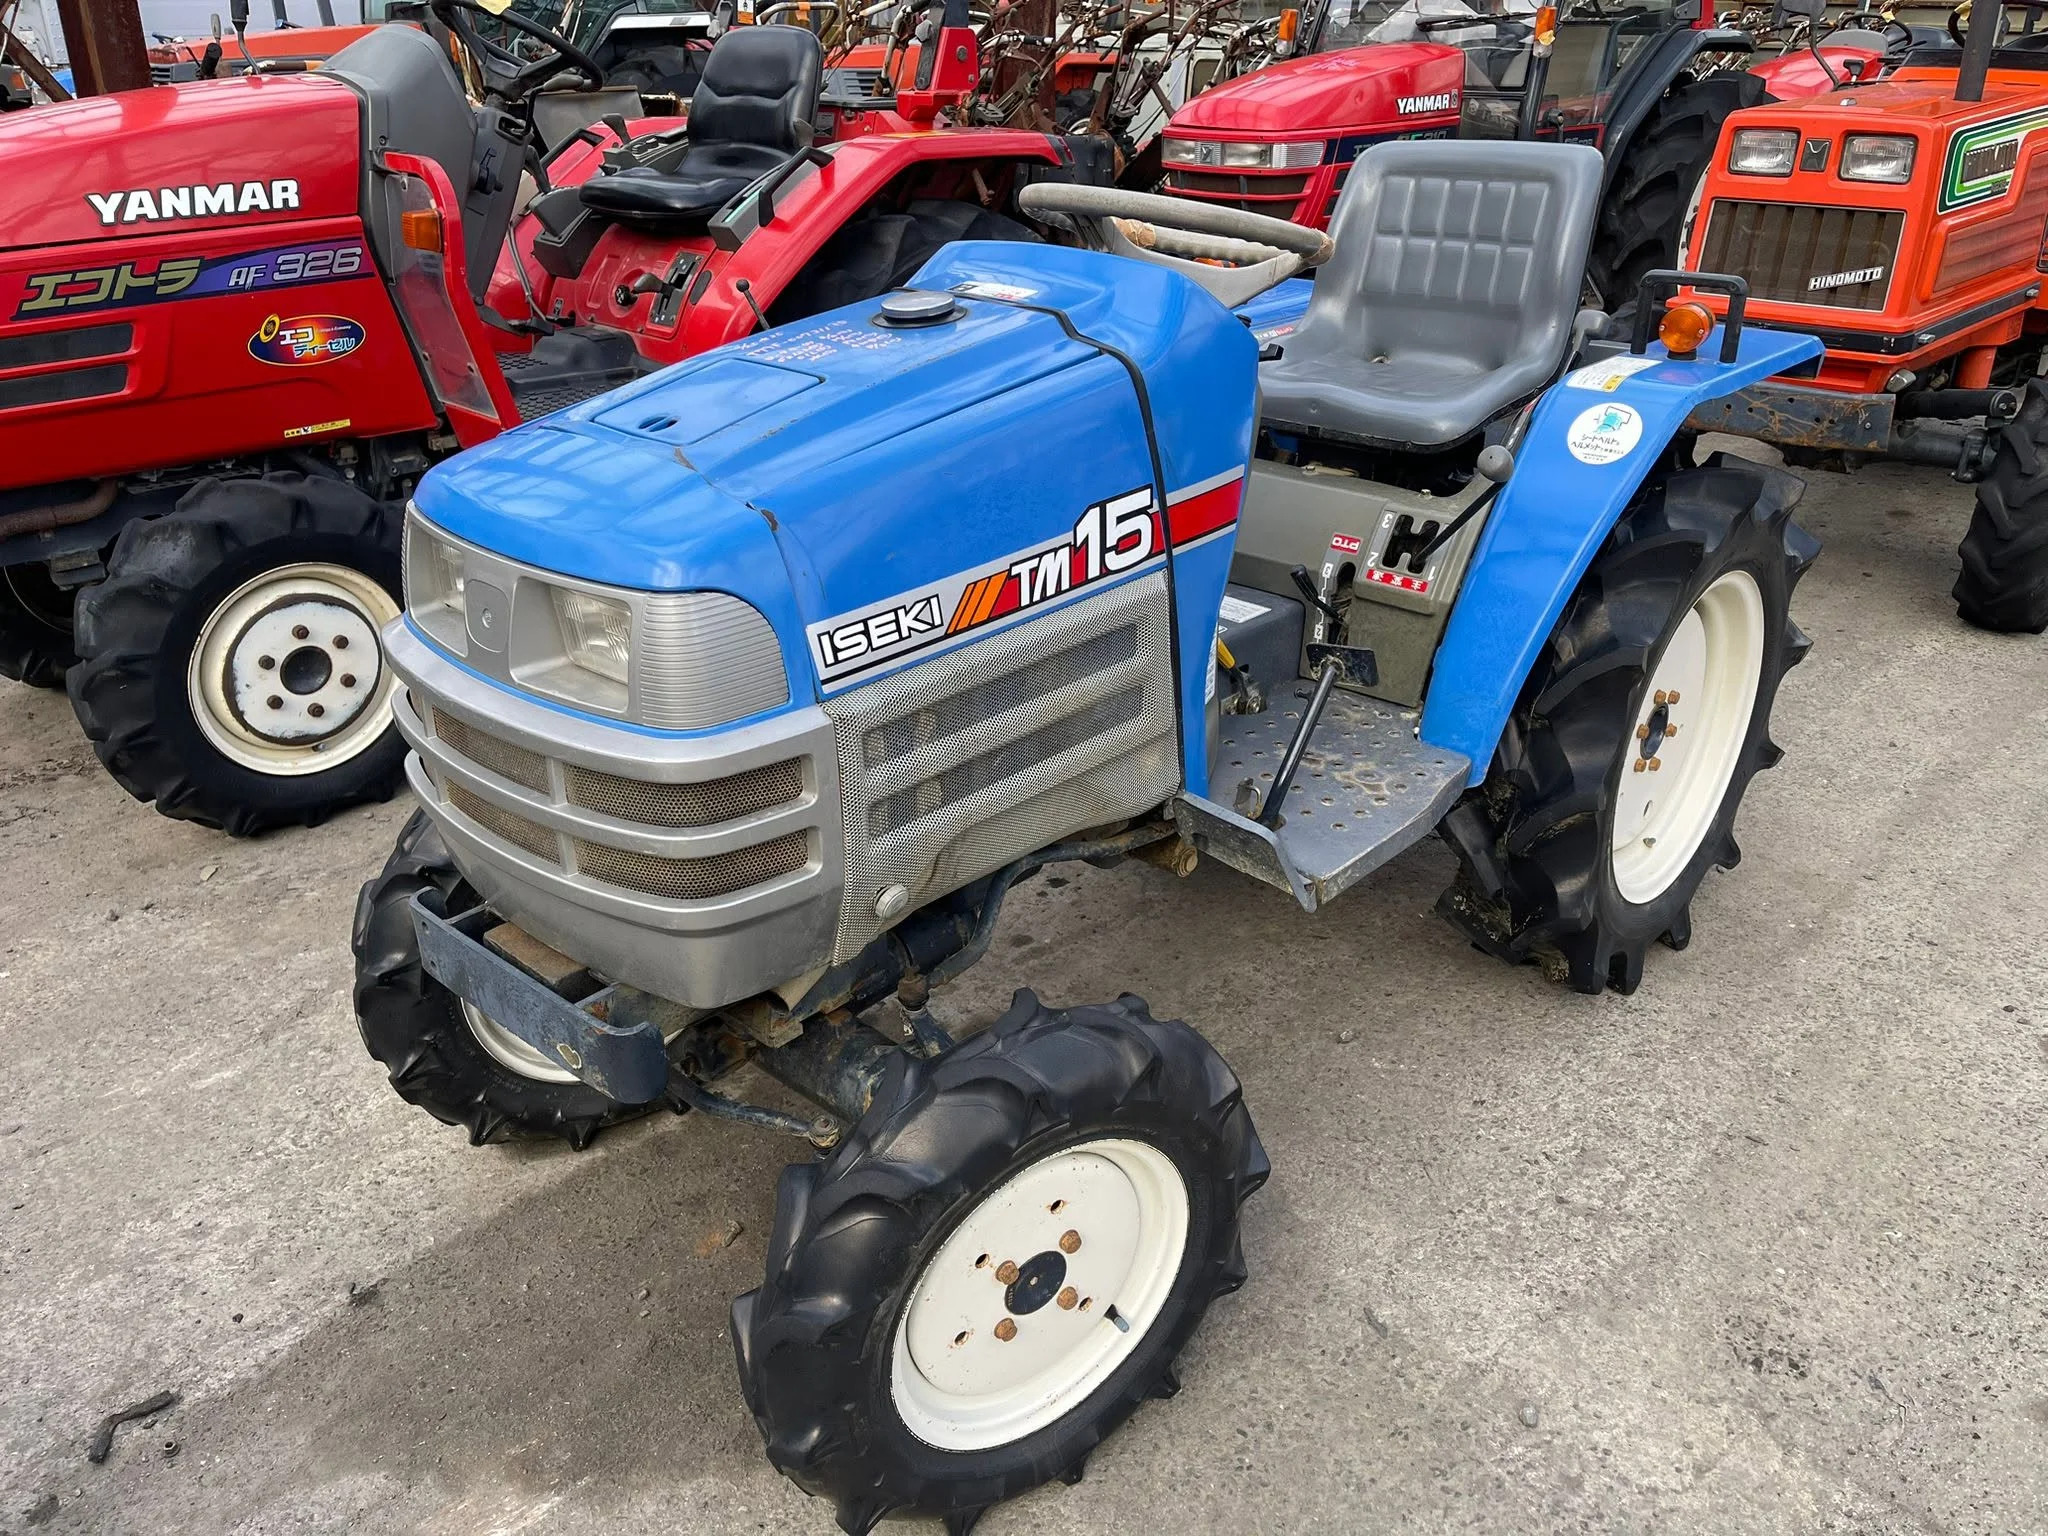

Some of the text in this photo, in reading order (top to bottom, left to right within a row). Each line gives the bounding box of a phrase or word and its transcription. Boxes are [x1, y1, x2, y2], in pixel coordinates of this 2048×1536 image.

[1397, 94, 1450, 114] YANMAR
[87, 179, 300, 223] YANMAR
[228, 246, 363, 290] AF 326
[1809, 266, 1882, 290] HINOMOTO
[21, 258, 201, 312] エコトラ
[279, 327, 314, 346] エコ
[293, 337, 355, 358] ディーゼル
[1382, 513, 1393, 529] 3
[1332, 536, 1360, 551] PTO
[1367, 552, 1379, 567] 2
[1371, 570, 1423, 590] 主変速
[1428, 566, 1436, 581] 1
[818, 596, 944, 666] ISEKI
